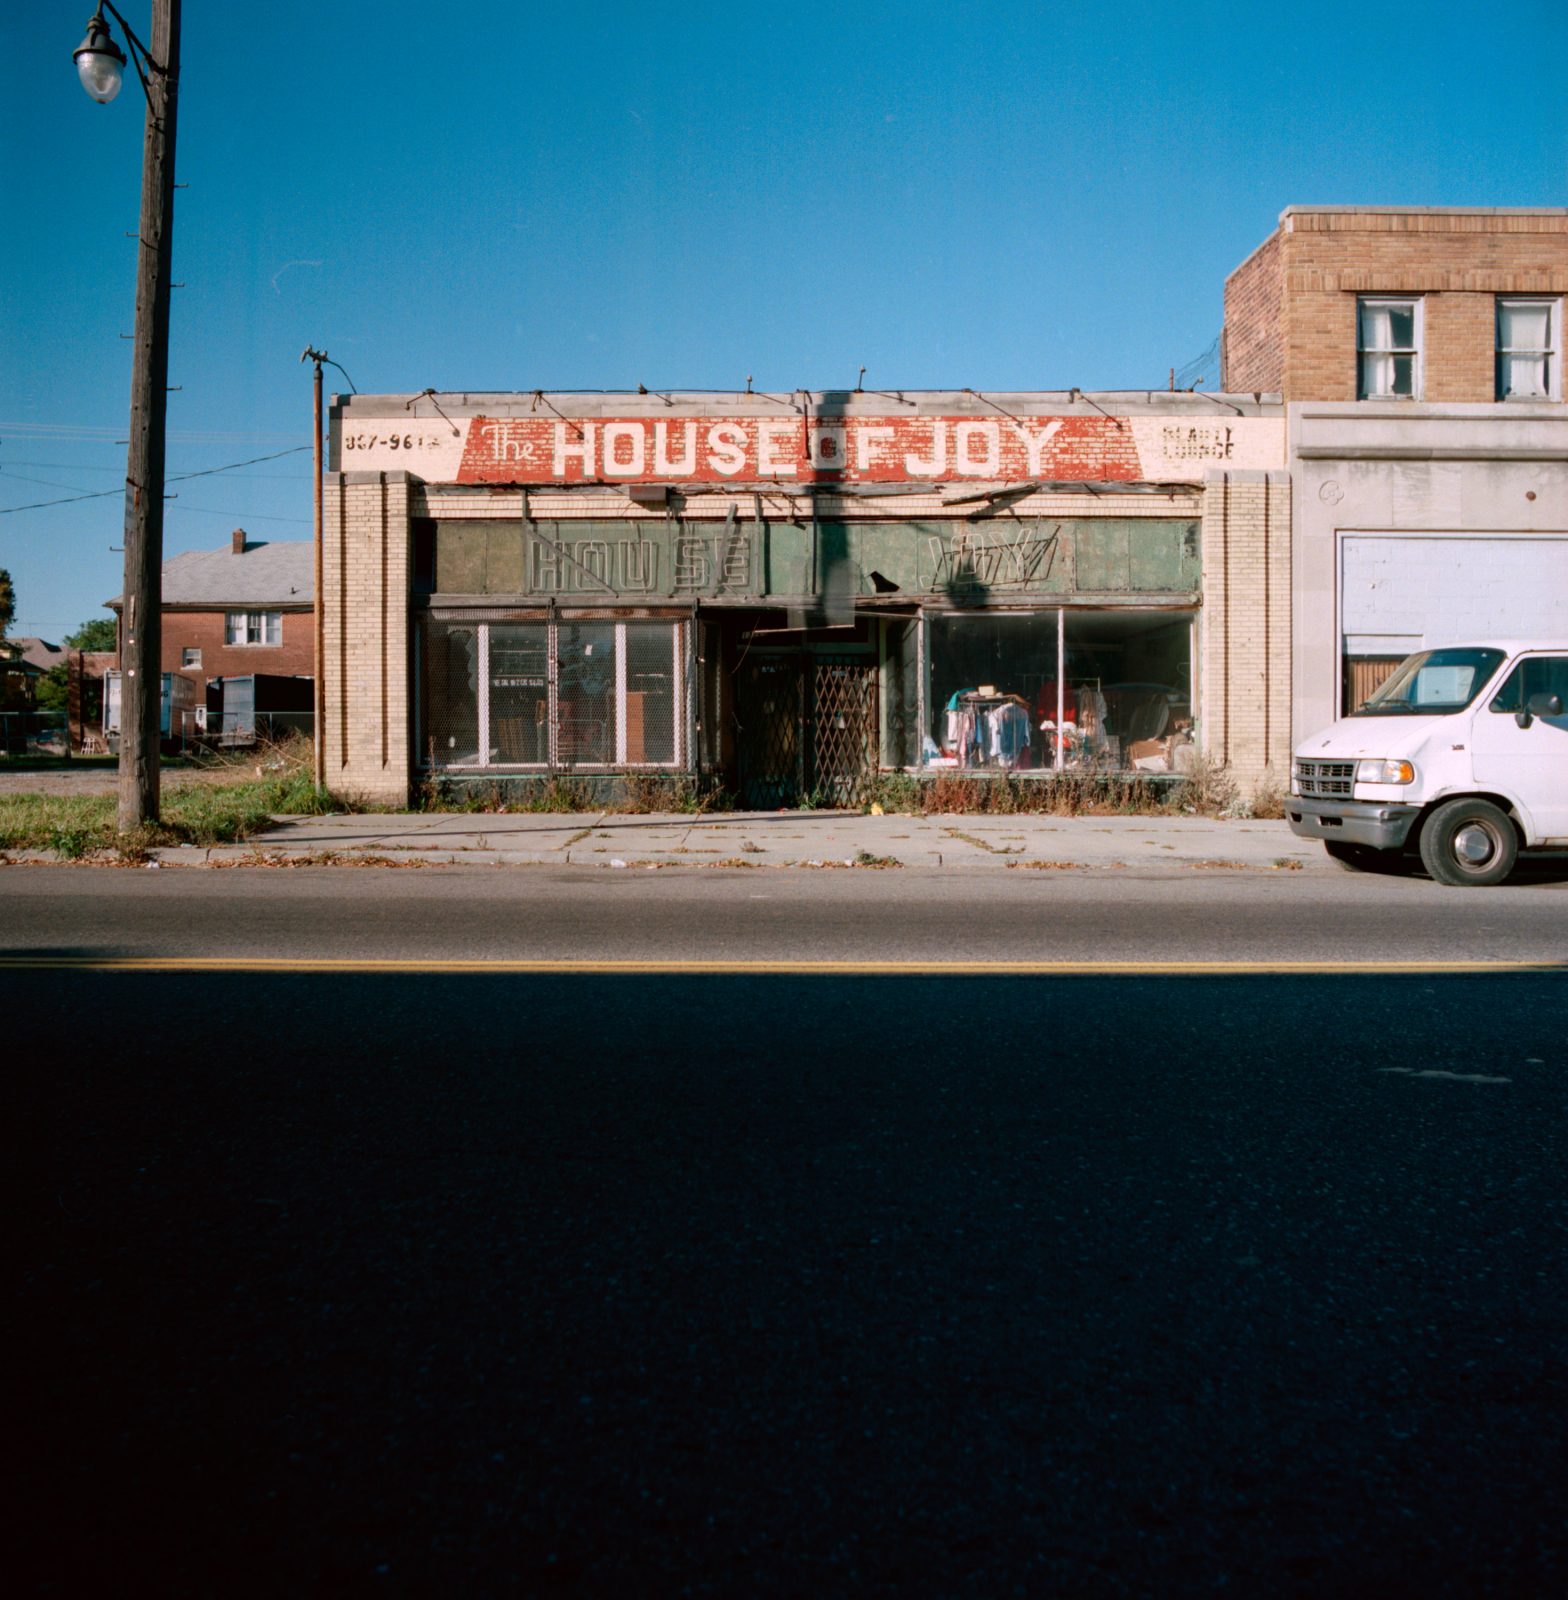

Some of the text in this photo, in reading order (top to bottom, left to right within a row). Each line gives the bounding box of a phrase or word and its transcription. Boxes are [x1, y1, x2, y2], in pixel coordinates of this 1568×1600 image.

[481, 421, 1064, 477] The HOUSE OF JOY
[532, 527, 1032, 590] HOUSE JOY
